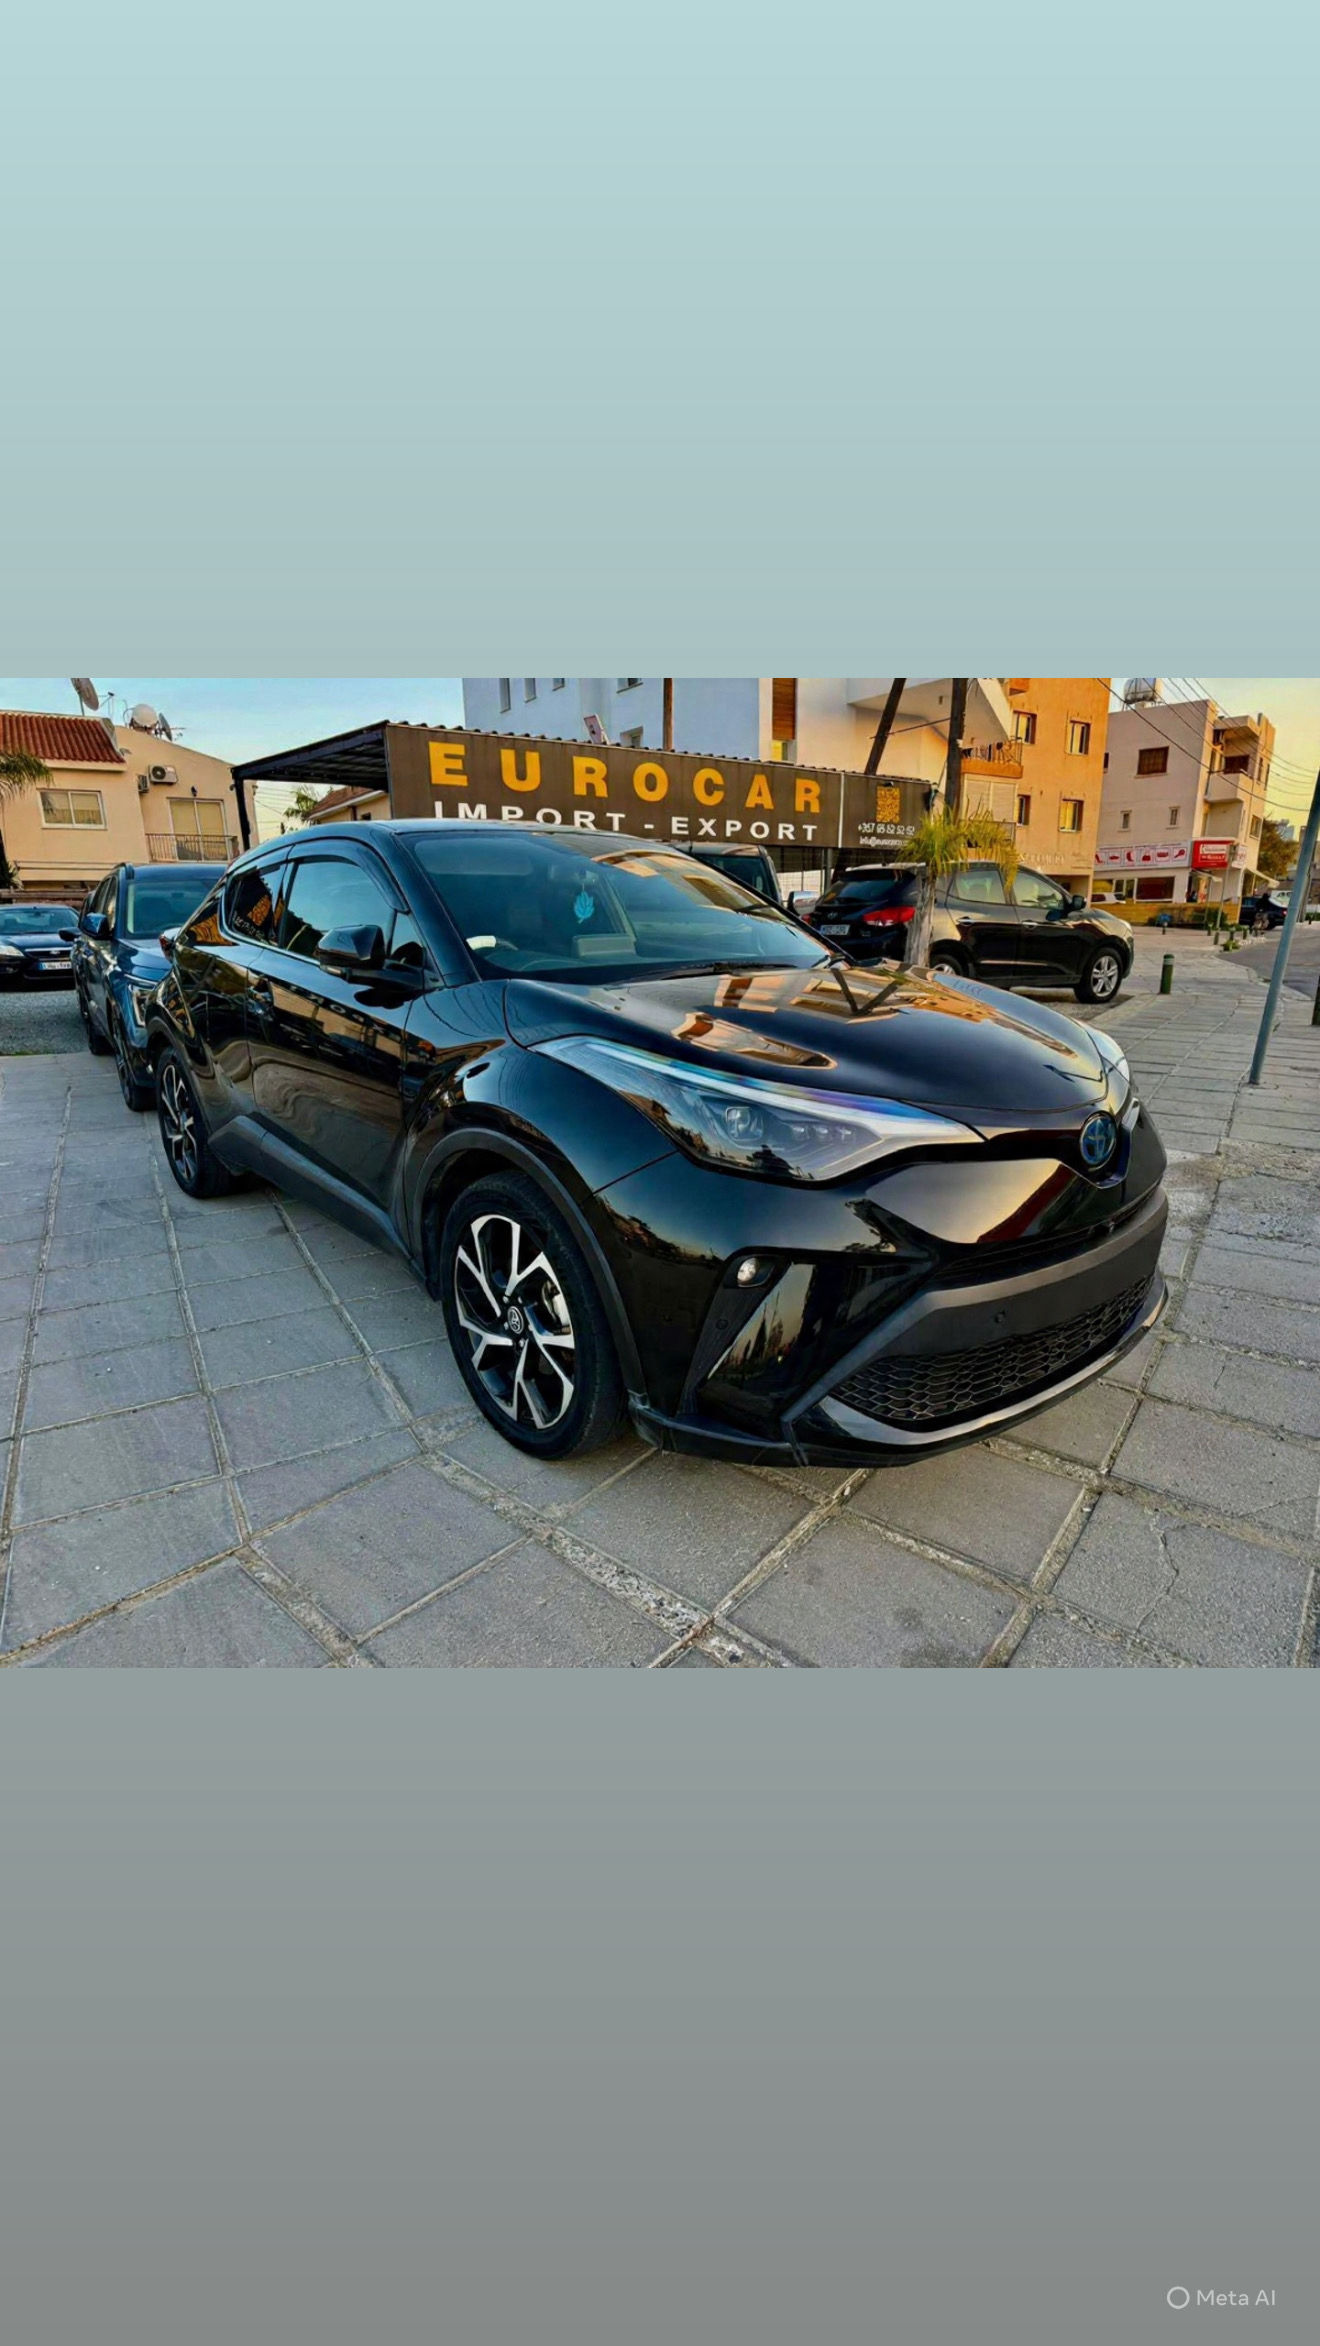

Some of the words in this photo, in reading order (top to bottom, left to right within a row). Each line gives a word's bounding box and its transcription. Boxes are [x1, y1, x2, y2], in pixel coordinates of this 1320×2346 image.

[428, 740, 821, 814] EUROCAR
[434, 800, 626, 832] IMPORT
[671, 816, 818, 842] EXPORT
